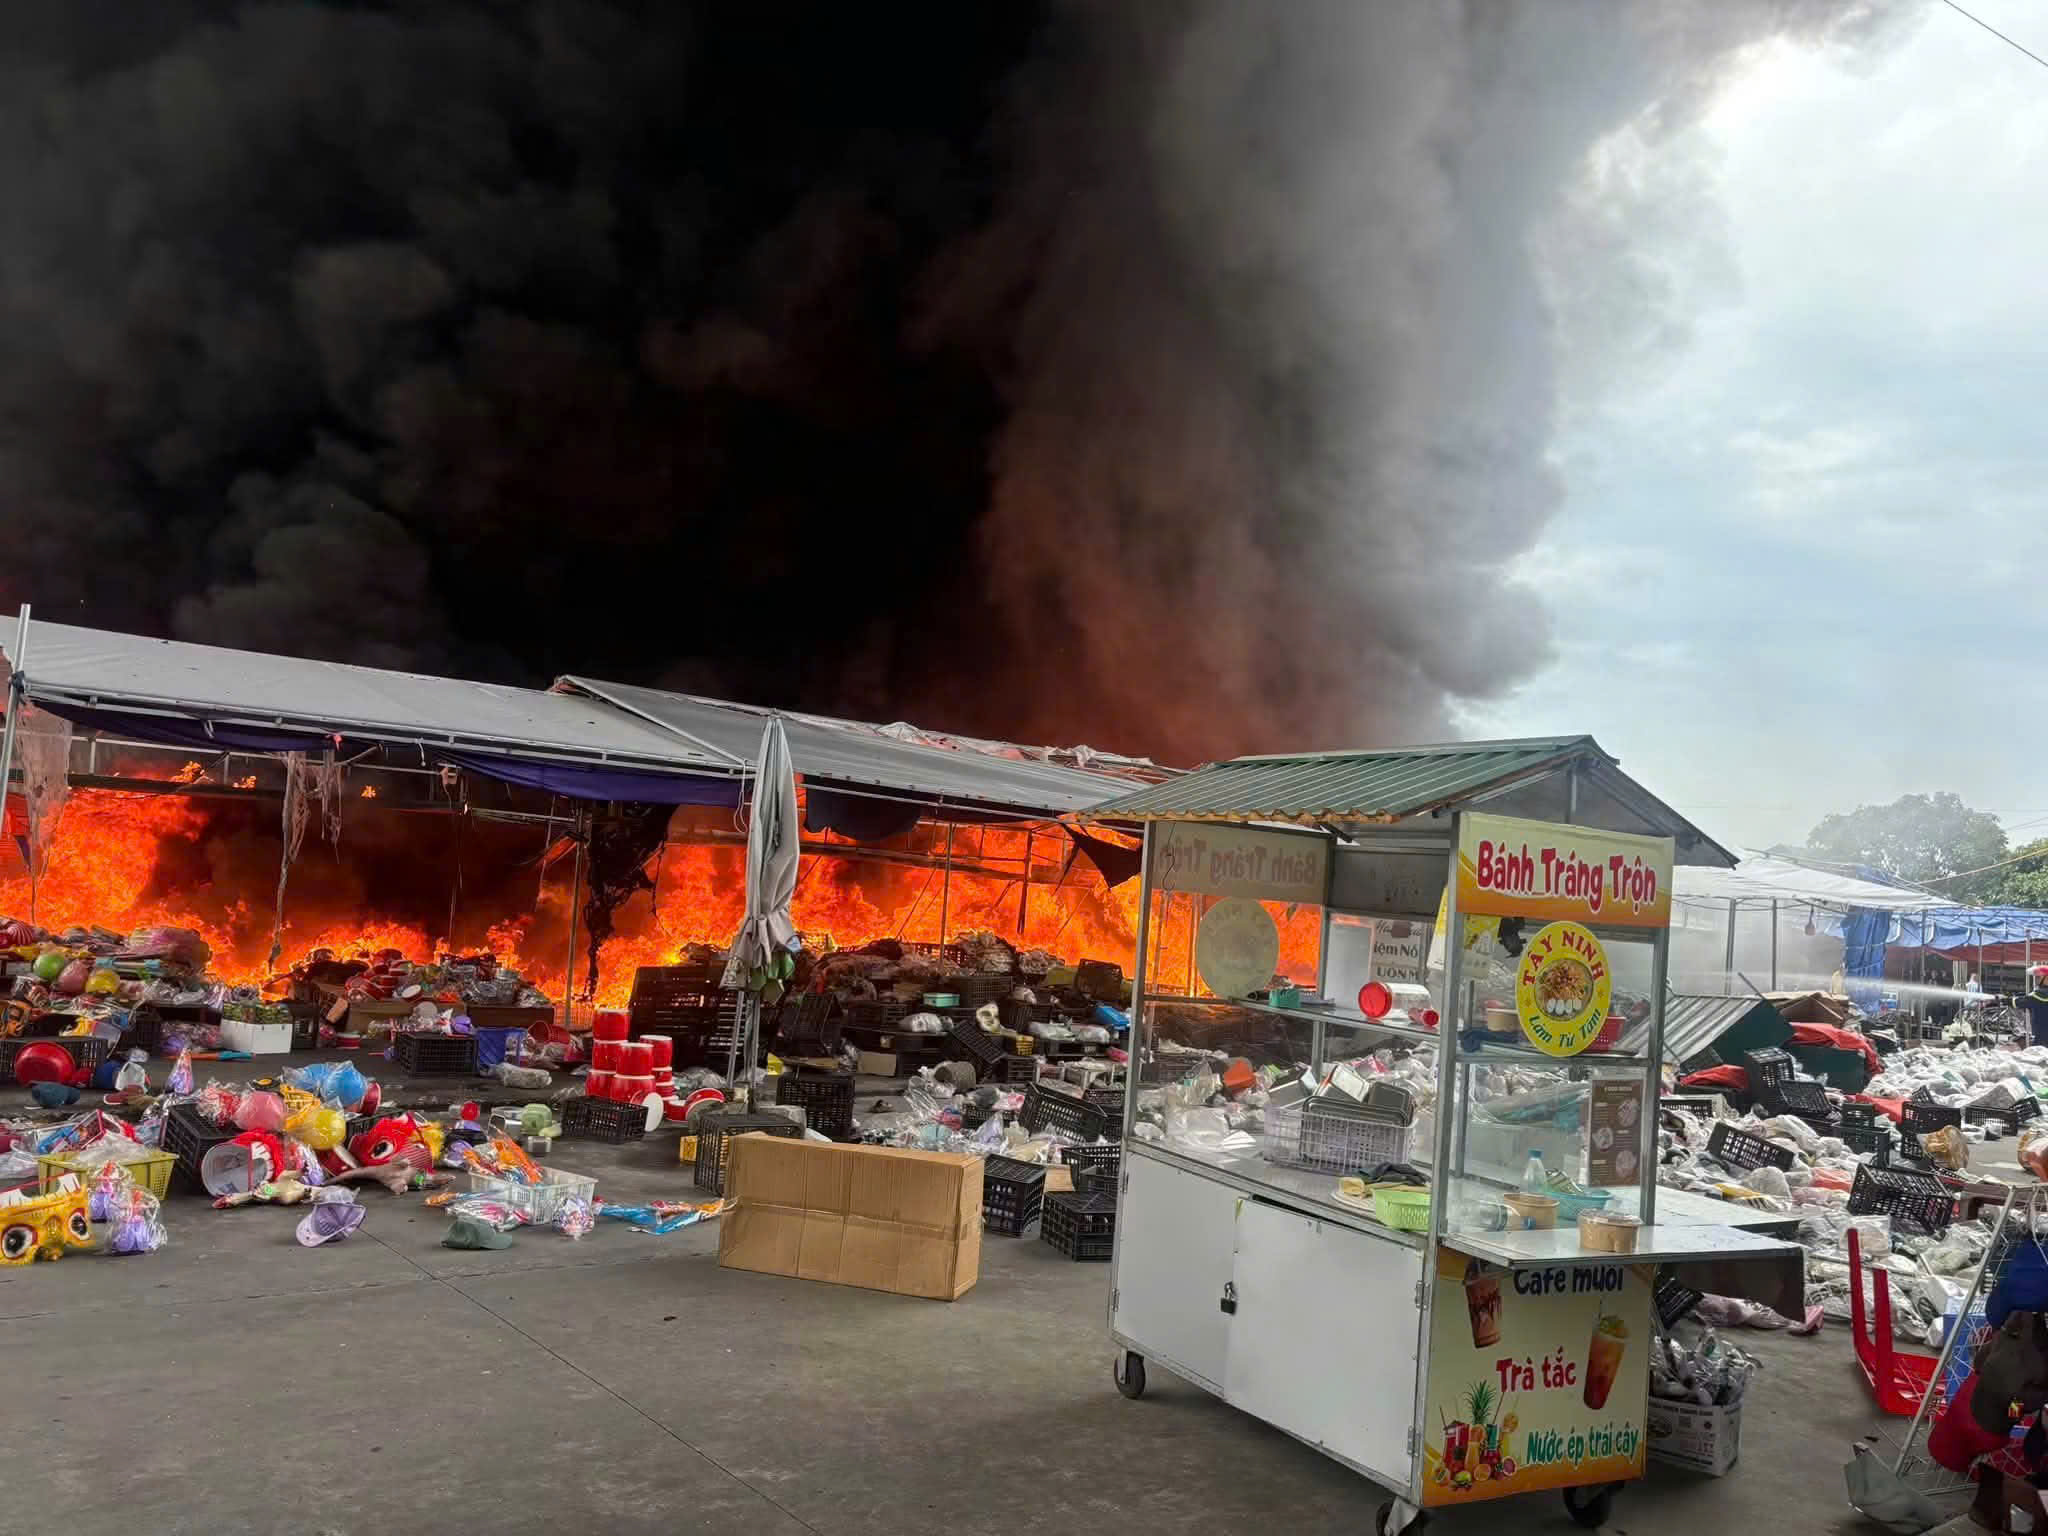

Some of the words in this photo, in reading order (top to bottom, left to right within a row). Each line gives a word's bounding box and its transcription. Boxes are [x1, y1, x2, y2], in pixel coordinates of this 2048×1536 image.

[1477, 839, 1535, 892] Bánh
[1540, 846, 1604, 913] Tráng
[1608, 853, 1657, 915] Trộn
[1374, 940, 1398, 957] iệm
[1561, 929, 1605, 982] NINH
[1495, 1355, 1536, 1393] Trà
[1541, 1345, 1577, 1389] tắc
[1526, 1427, 1564, 1465] Nước
[1567, 1425, 1585, 1468] ép
[1589, 1421, 1613, 1458] trái
[1615, 1420, 1640, 1462] cây
